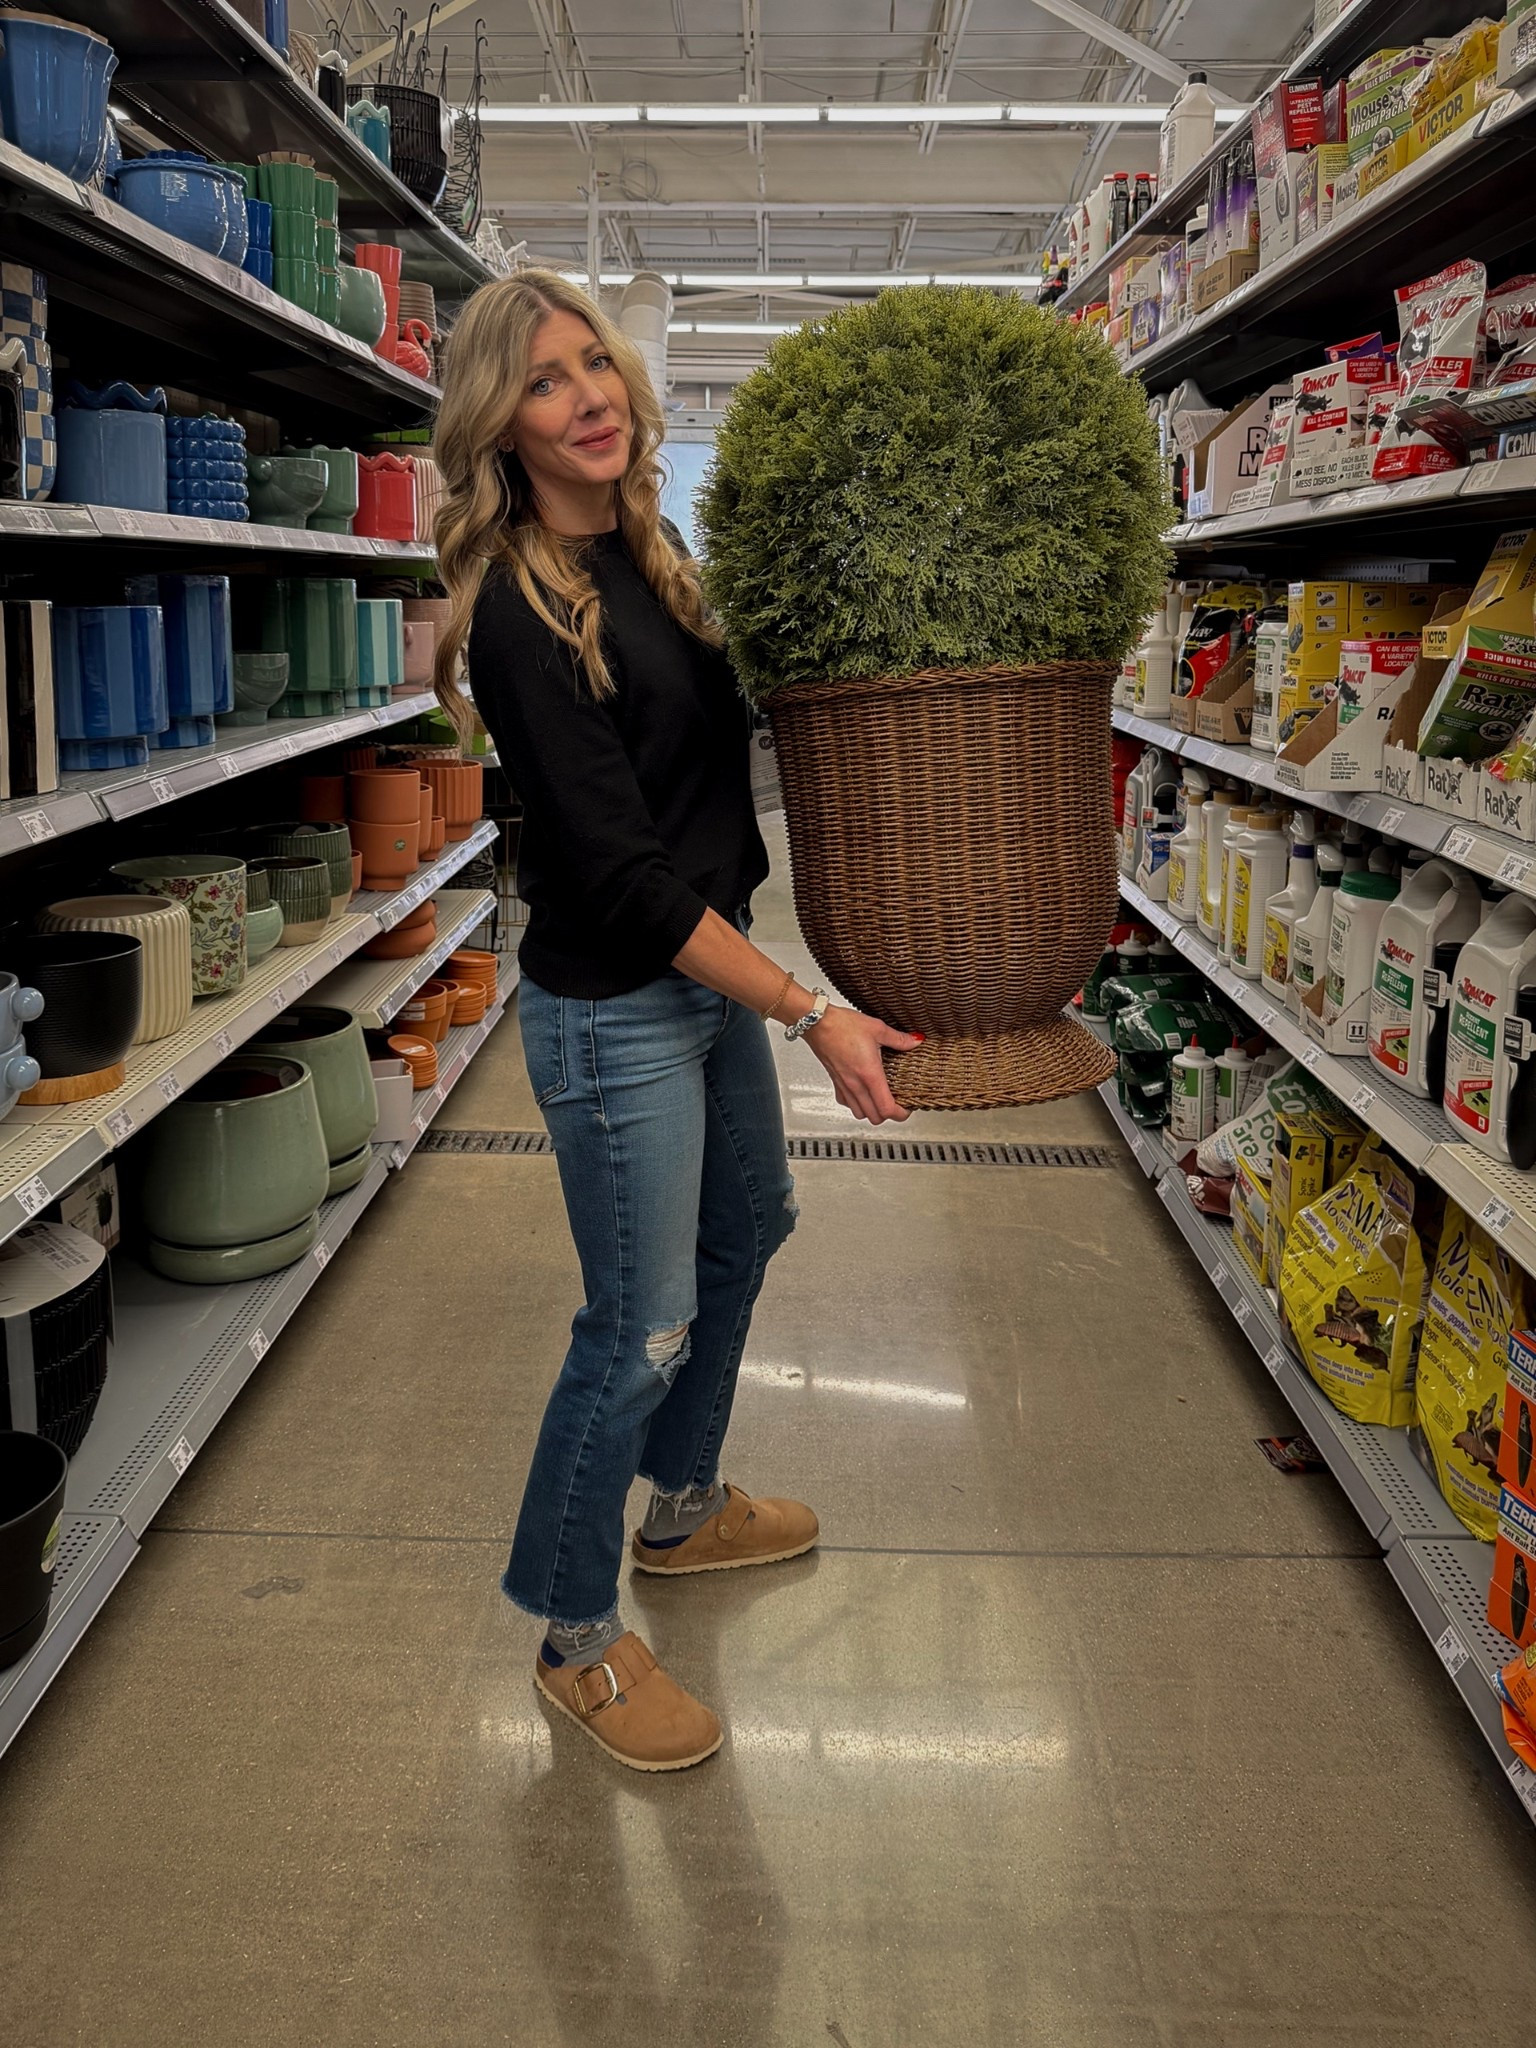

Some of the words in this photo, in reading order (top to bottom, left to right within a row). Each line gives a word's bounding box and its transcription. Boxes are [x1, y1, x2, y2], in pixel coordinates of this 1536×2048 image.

[1364, 80, 1378, 91] KILLS
[1379, 71, 1392, 84] MICE
[1288, 83, 1318, 94] ELIMINATOR
[1289, 106, 1322, 116] REPELLERS
[1419, 94, 1464, 144] VICTOR
[1301, 372, 1340, 394] TOMCAT
[1373, 402, 1395, 415] TOMC
[1468, 400, 1536, 426] COMBA
[1307, 417, 1317, 425] KILL
[1322, 412, 1345, 422] CONTAIN
[1342, 455, 1354, 465] EACH
[1355, 454, 1368, 462] BLOCK
[1427, 454, 1438, 463] 16
[1304, 468, 1313, 476] NO
[1312, 466, 1326, 476] SEE,
[1327, 463, 1338, 472] NO
[1342, 464, 1354, 472] KILLS
[1362, 462, 1368, 470] TO
[1352, 470, 1364, 479] MICE
[1295, 478, 1312, 489] MESS
[1497, 534, 1528, 549] VICTOR
[1424, 631, 1448, 644] VICTOR
[1376, 645, 1389, 653] CAN
[1390, 645, 1400, 653] BE
[1387, 653, 1413, 661] VARIETY
[1256, 664, 1273, 675] SNAKE
[1343, 665, 1366, 684] TOMCAT
[1476, 672, 1499, 682] KILLS
[1501, 677, 1519, 686] RATS
[1387, 938, 1415, 964] TOMCAT
[1381, 970, 1408, 993] REPELLENT
[1464, 977, 1497, 1008] TOMCAT
[1459, 1014, 1489, 1041] REPELLENT
[1505, 1025, 1522, 1034] WAND
[1347, 1375, 1365, 1386] burrow
[1511, 1375, 1520, 1385] Ant
[1521, 1381, 1533, 1395] Bait
[1503, 1527, 1515, 1539] Ant
[1515, 1536, 1529, 1550] Bait
